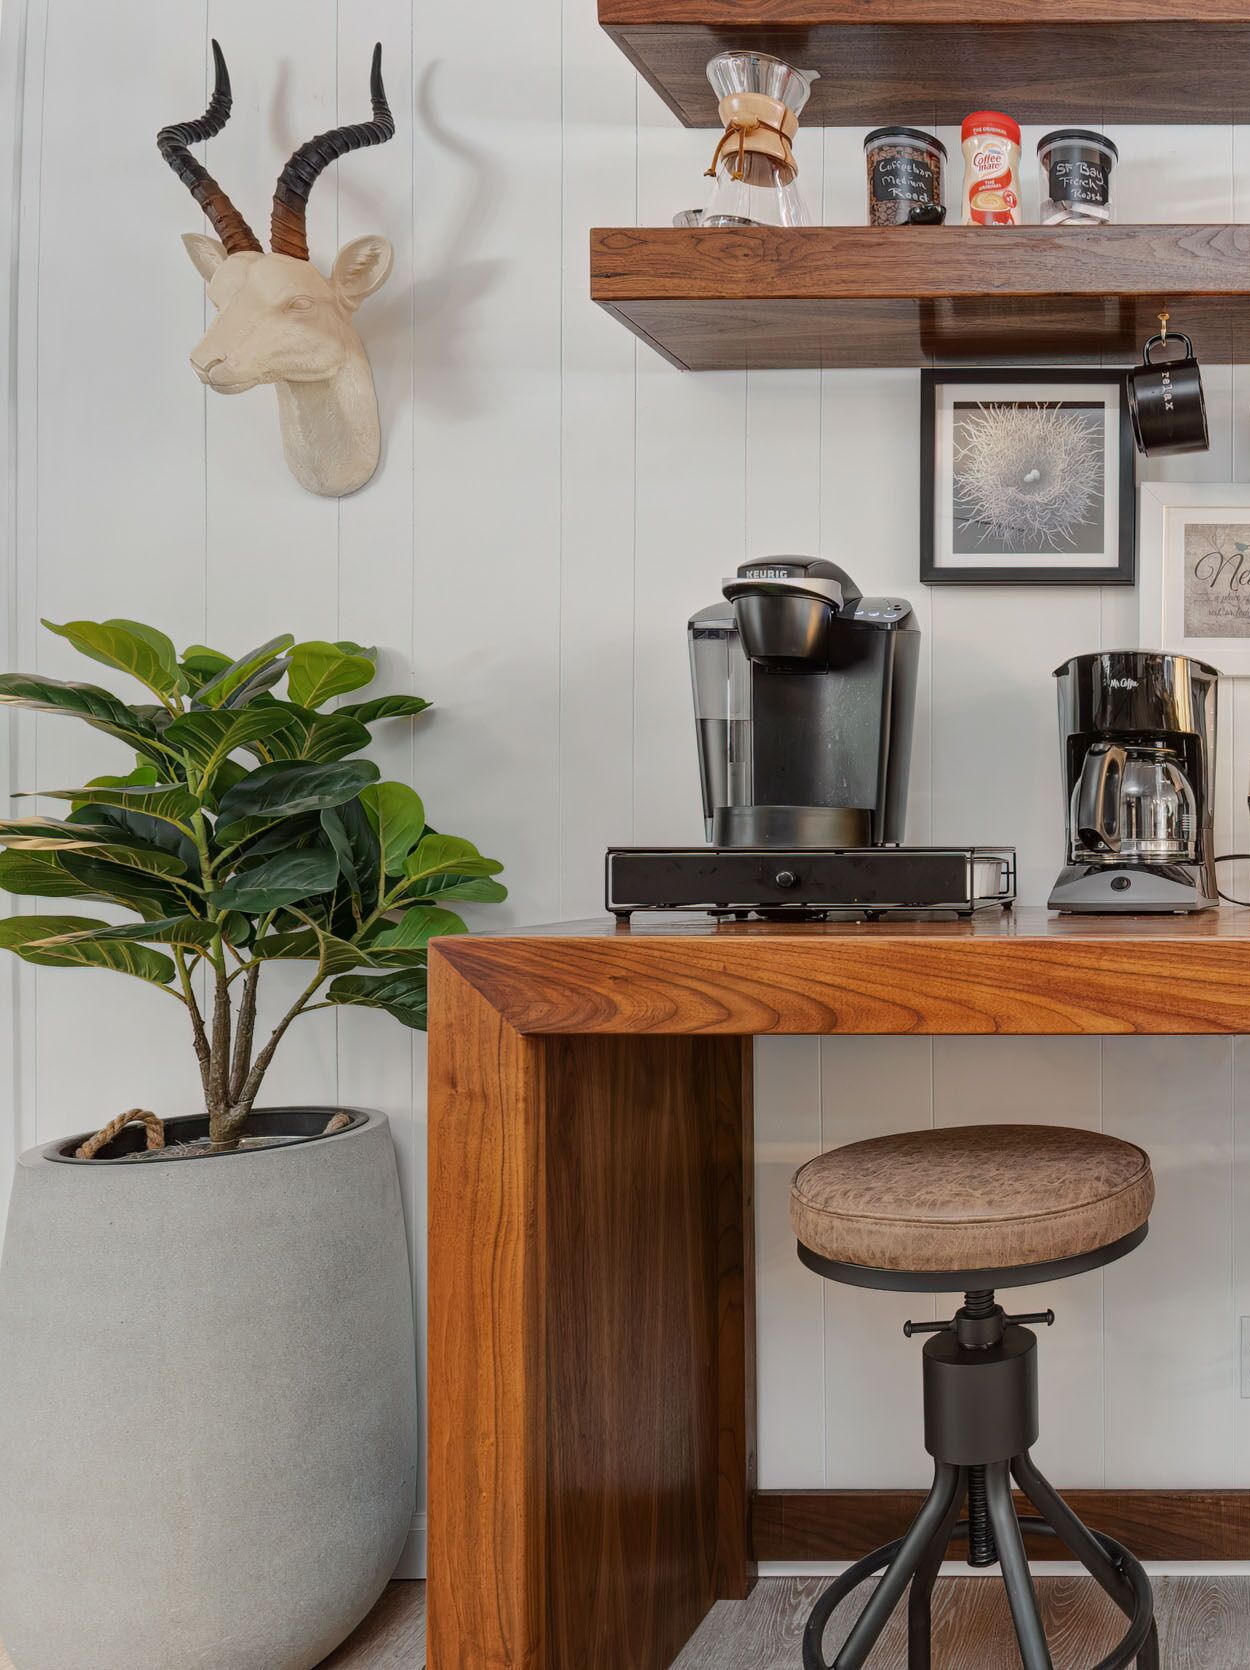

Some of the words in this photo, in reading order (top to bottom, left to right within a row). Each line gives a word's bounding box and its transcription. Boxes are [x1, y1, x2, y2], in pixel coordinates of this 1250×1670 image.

[973, 152, 1002, 167] Coffee
[1075, 161, 1104, 185] Bay
[1161, 371, 1174, 411] relax
[746, 569, 788, 579] KEURIG
